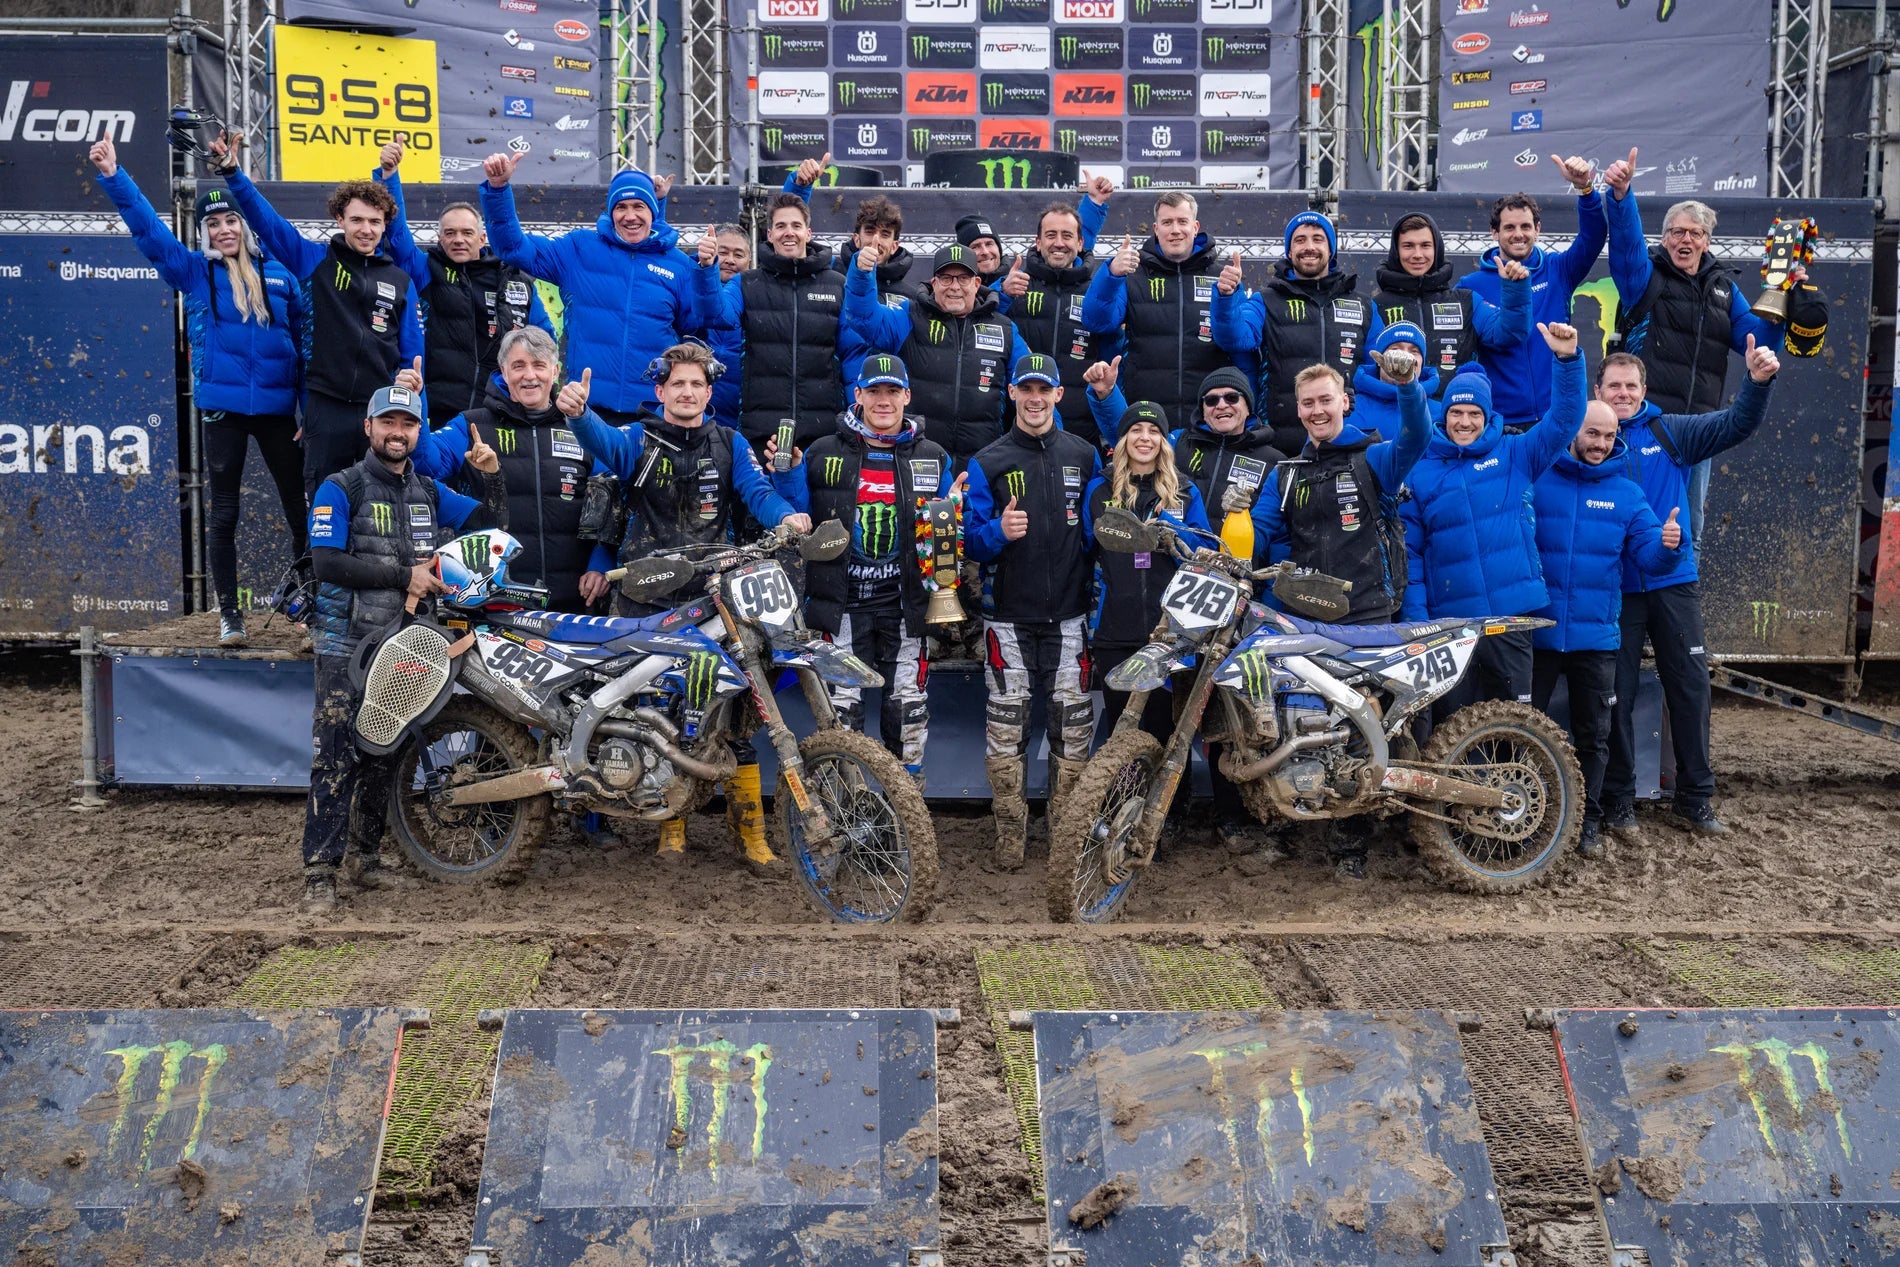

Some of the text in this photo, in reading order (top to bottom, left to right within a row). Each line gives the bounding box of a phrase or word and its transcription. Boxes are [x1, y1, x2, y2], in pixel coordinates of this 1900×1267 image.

[770, 0, 818, 16] MOLY
[1065, 4, 1114, 18] MOLY
[558, 25, 587, 36] Twin Air
[783, 39, 825, 48] MONSTER
[931, 40, 972, 50] MONSTER
[1078, 41, 1120, 50] MONSTER
[1225, 41, 1267, 50] MONSTER
[1456, 39, 1487, 49] Twin Air
[847, 54, 887, 63] Husqvarna
[1142, 56, 1182, 65] Husqvarna
[555, 87, 590, 97] HINSON
[857, 86, 899, 95] MONSTER
[915, 85, 969, 102] KTM
[1005, 87, 1046, 96] MONSTER
[1063, 86, 1117, 104] KTM
[1151, 88, 1193, 97] MONSTER
[1453, 99, 1490, 110] HINSON
[568, 119, 590, 129] UFO
[289, 123, 433, 151] SANTERO
[783, 133, 825, 141] MONSTER
[931, 133, 972, 142] MONSTER
[989, 132, 1042, 149] KTM
[1078, 135, 1119, 143] MONSTER
[1225, 135, 1266, 143] MONSTER
[847, 147, 887, 156] Husqvarna
[1141, 149, 1181, 158] Husqvarna
[1713, 174, 1758, 191] infront
[77, 264, 159, 281] Husqvarna
[653, 265, 675, 278] YAMAHA
[814, 293, 836, 302] YAMAHA
[1442, 317, 1461, 325] YAMAHA
[1793, 325, 1826, 337] PIRELLI
[876, 375, 903, 385] YAMAHA
[1024, 372, 1052, 382] YAMAHA
[561, 444, 580, 453] YAMAHA
[1591, 500, 1615, 510] YAMAHA
[1098, 526, 1133, 540] ACERBIS
[848, 561, 901, 580] YAMAHA
[637, 571, 675, 586] ACERBIS
[740, 569, 793, 618] 959
[1166, 573, 1236, 621] 243
[1296, 592, 1338, 610] ACERBIS
[512, 615, 542, 629] YAMAHA
[1410, 624, 1442, 638] YAMAHA
[1486, 626, 1505, 634] PIRELLI
[1456, 638, 1476, 648] MXGP
[485, 642, 554, 687] 959
[1406, 645, 1459, 693] 243
[604, 759, 628, 769] YAMAHA
[787, 771, 809, 804] PIRELLI
